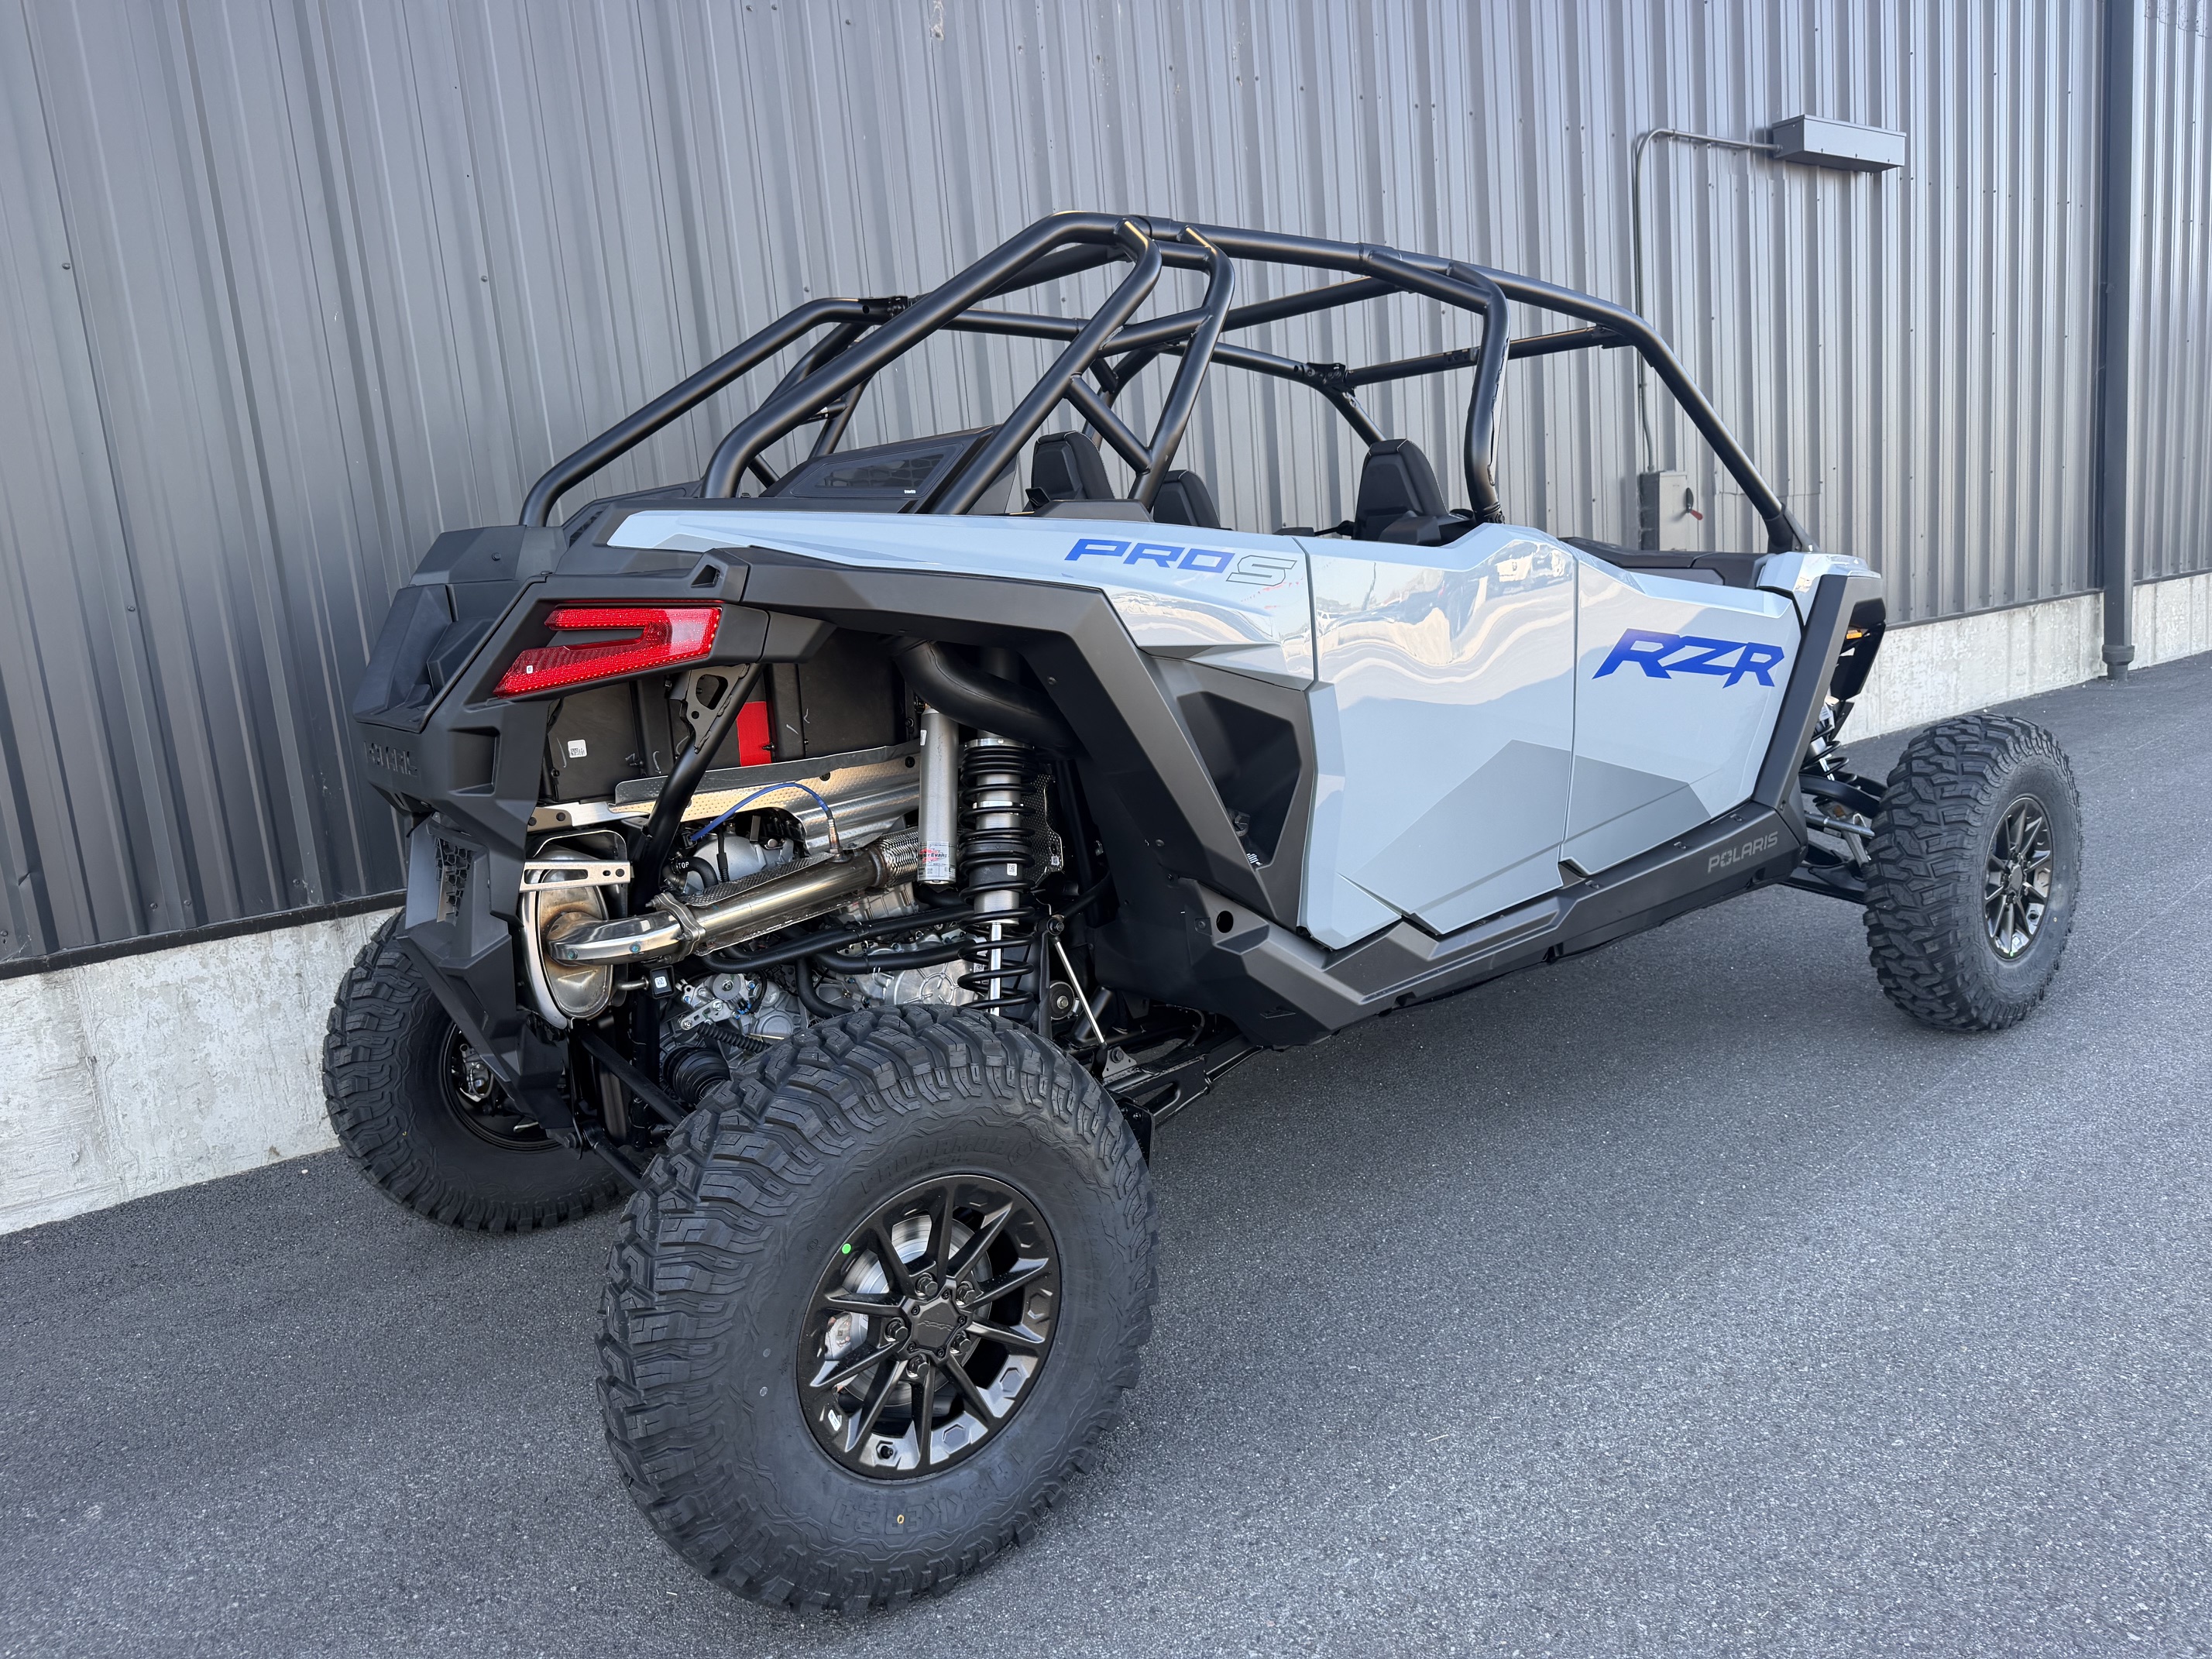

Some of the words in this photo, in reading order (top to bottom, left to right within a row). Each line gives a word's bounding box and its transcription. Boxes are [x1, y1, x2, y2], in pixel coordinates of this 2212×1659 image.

[1064, 538, 1235, 573] PRO
[1226, 555, 1297, 586] S
[1592, 628, 1784, 689] RZR
[1707, 831, 1778, 873] POLARIS
[917, 1134, 1011, 1162] ARMOR
